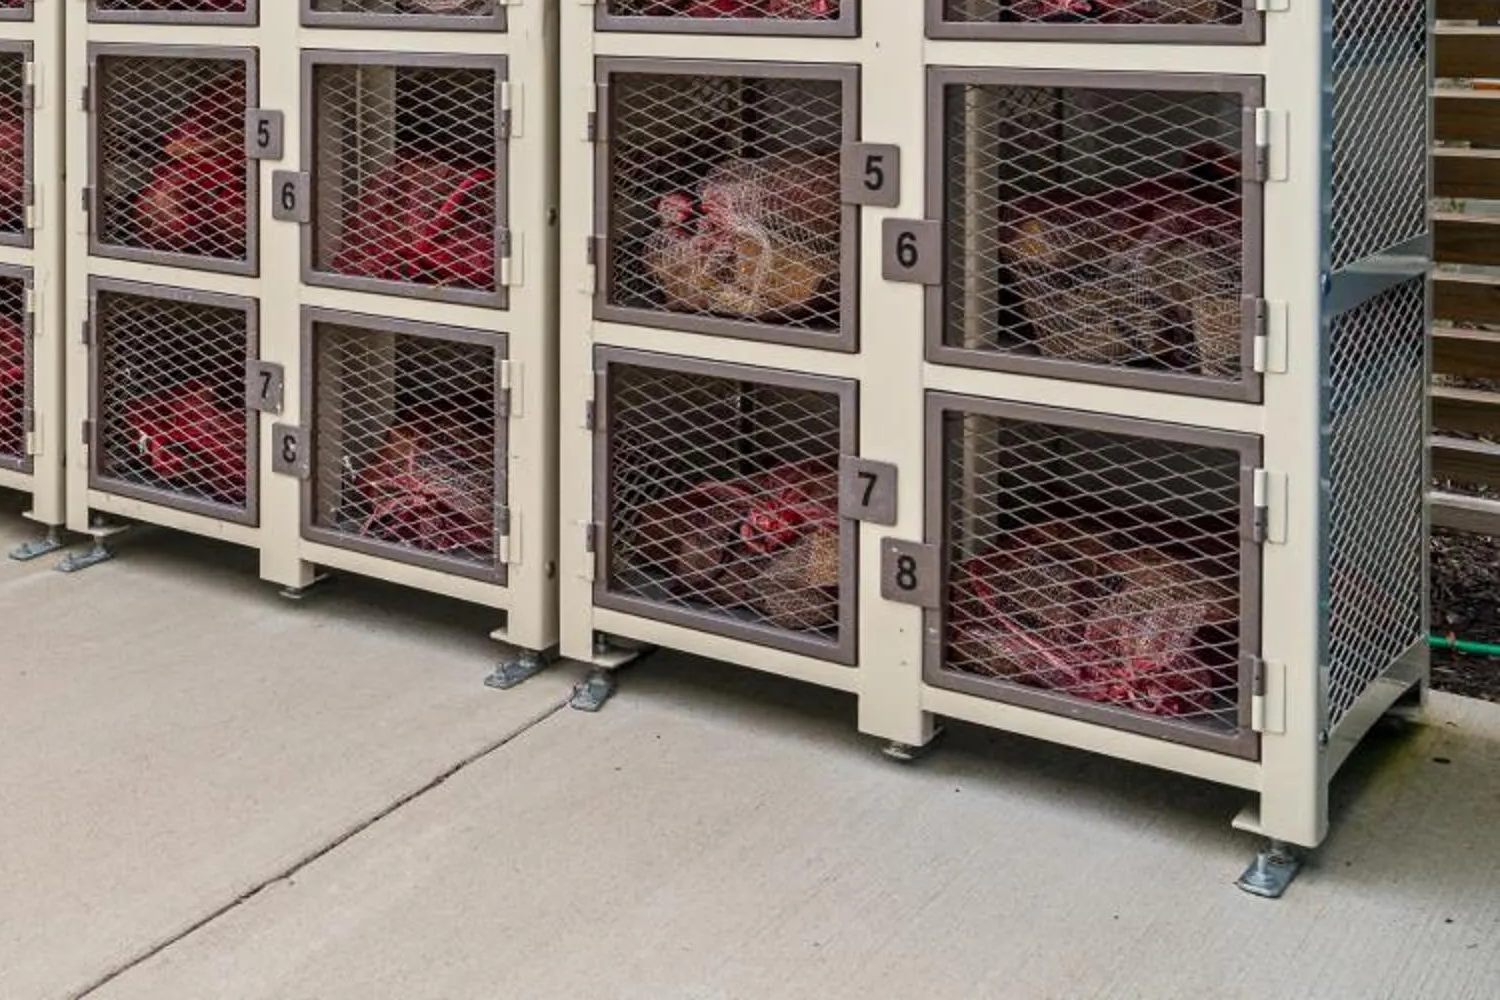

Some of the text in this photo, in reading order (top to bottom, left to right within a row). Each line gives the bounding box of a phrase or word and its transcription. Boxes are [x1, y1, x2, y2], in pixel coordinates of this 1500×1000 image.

[257, 120, 269, 148] 5
[863, 155, 884, 190] 5
[281, 182, 295, 210] 6
[896, 231, 918, 268] 6
[260, 371, 272, 399] 7
[858, 472, 878, 506] 7
[896, 555, 917, 590] 8
